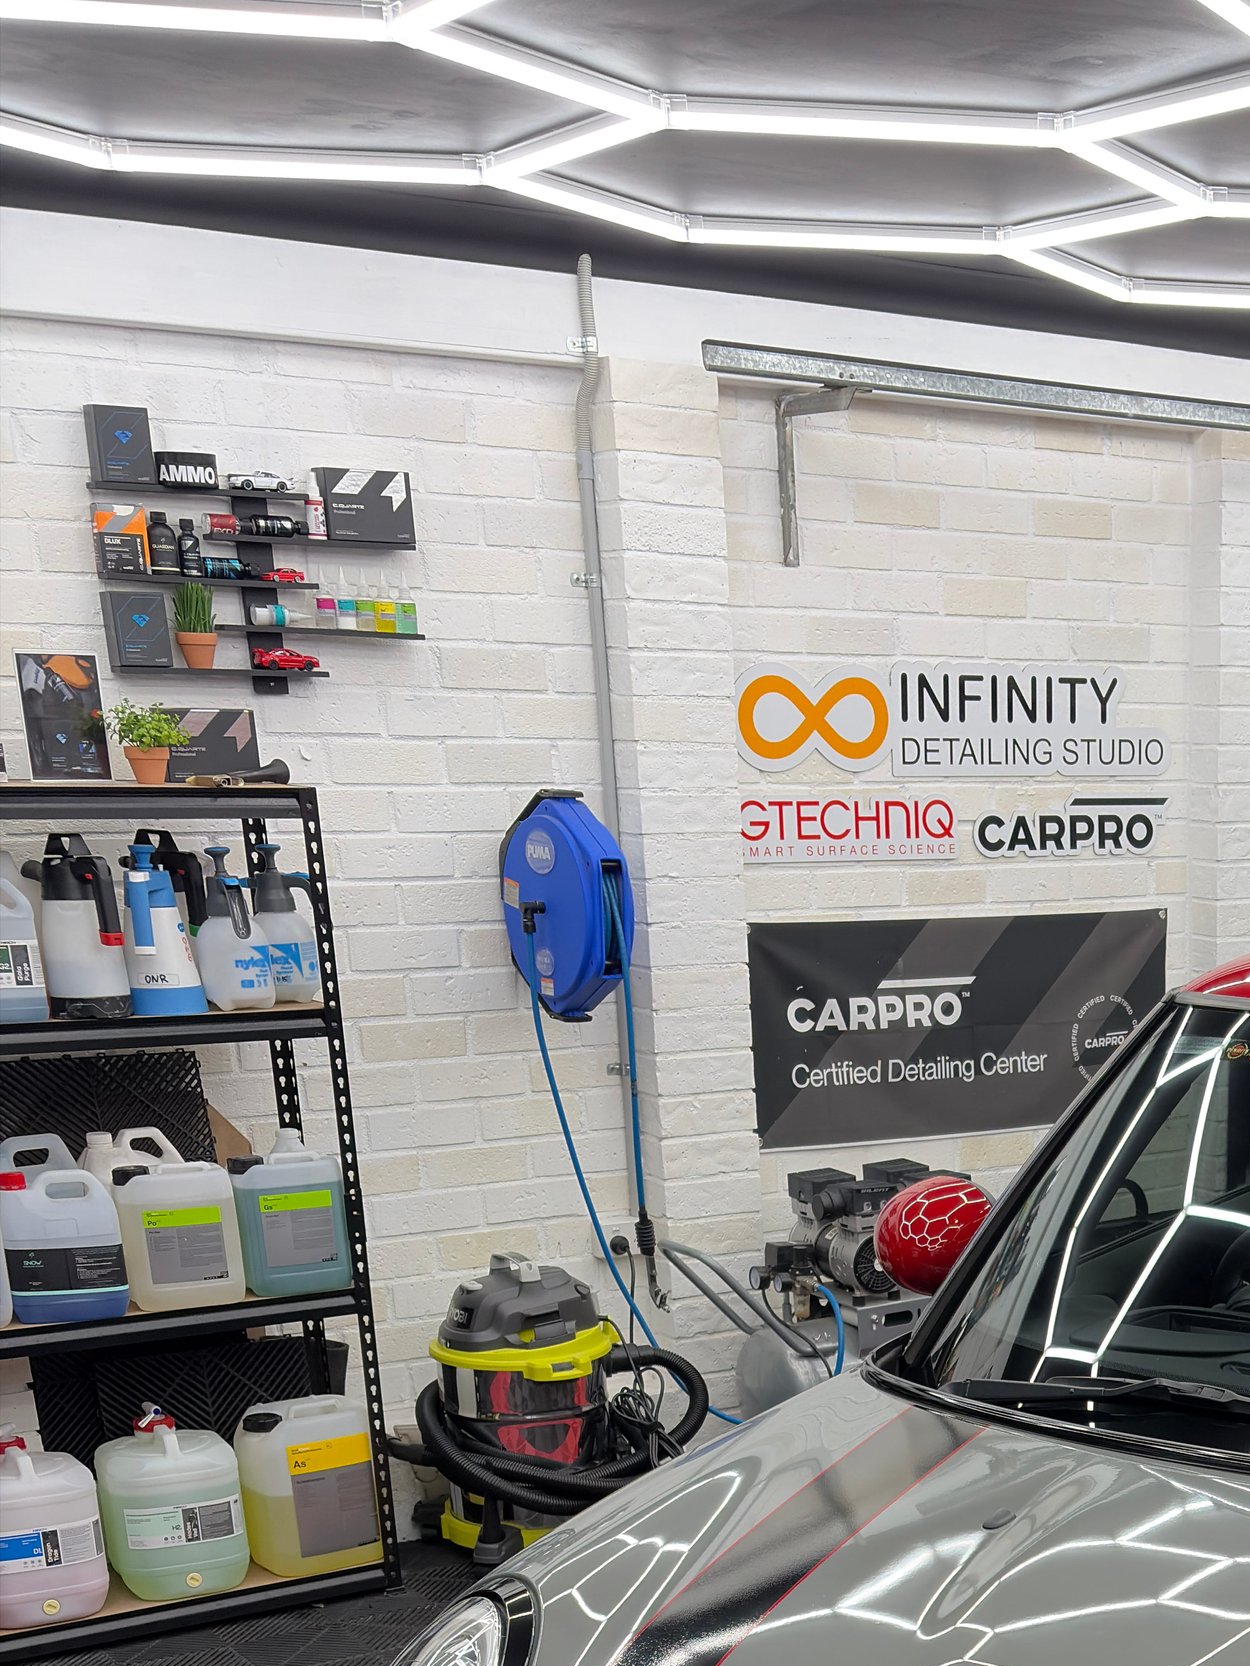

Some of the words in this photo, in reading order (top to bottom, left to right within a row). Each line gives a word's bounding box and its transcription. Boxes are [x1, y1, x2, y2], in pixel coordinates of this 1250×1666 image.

[160, 464, 216, 485] AMMO
[104, 537, 121, 545] DLUX
[900, 672, 1118, 724] INFINITY
[901, 737, 1052, 765] DETAILING
[1062, 738, 1164, 765] STUDIO
[740, 799, 955, 841] GTECHNIQ
[977, 813, 1154, 852] CARPRO
[527, 844, 551, 860] PUMA
[742, 846, 795, 857] MART
[806, 845, 879, 857] SURFACE
[888, 843, 956, 855] SCIENCE
[144, 973, 169, 984] ONR
[786, 991, 962, 1033] CARPRO
[1077, 995, 1105, 1019] CERTIFIED
[1109, 994, 1134, 1016] CERTIFIED
[1071, 1023, 1079, 1062] CERTIFIED
[1084, 1035, 1125, 1049] CARPRO
[791, 1059, 882, 1089] Certified
[888, 1055, 974, 1083] Detailing
[980, 1051, 1048, 1077] Center
[147, 1219, 157, 1227] Po
[293, 1460, 307, 1469] As
